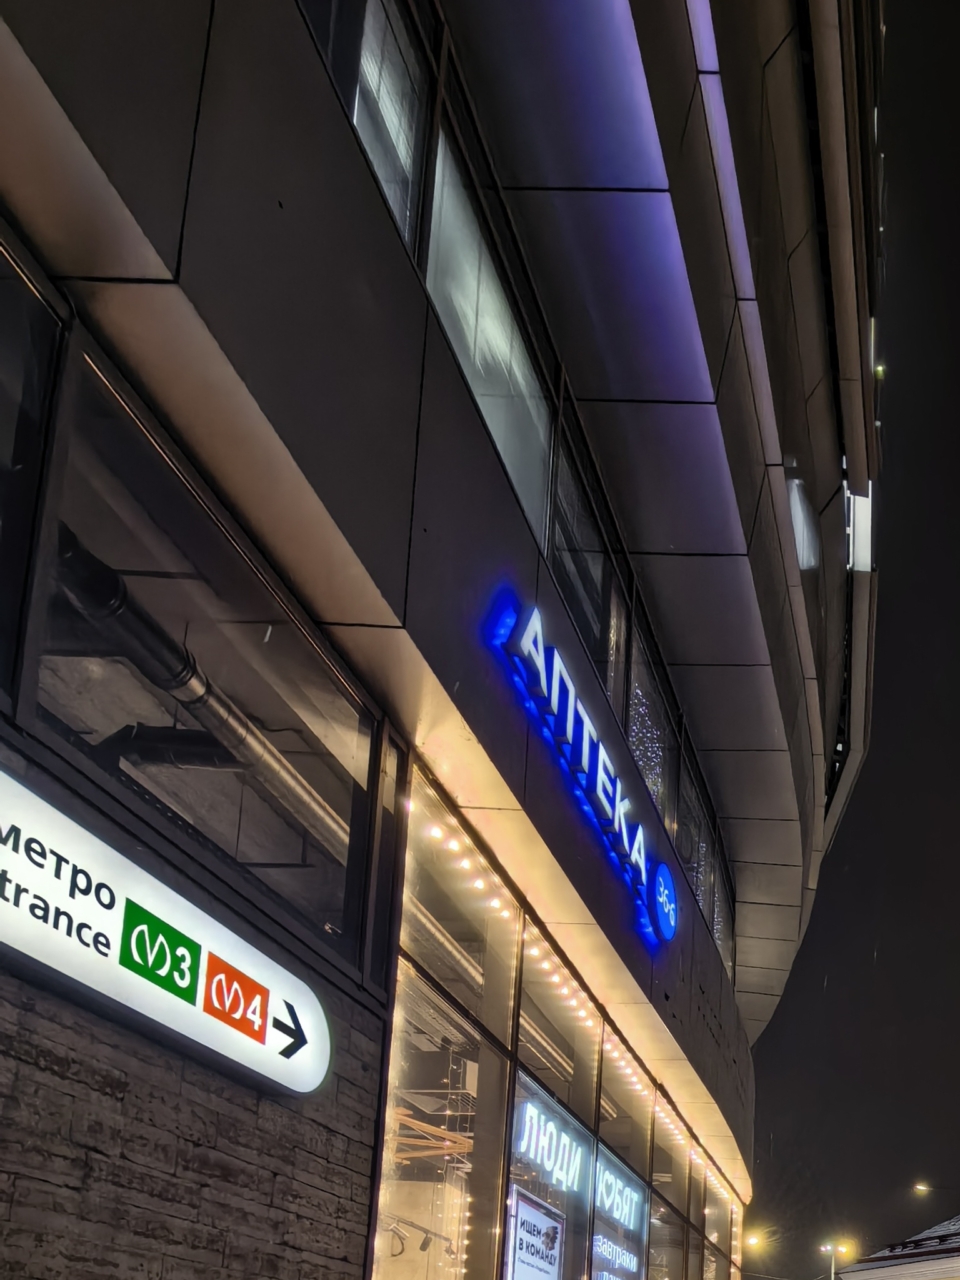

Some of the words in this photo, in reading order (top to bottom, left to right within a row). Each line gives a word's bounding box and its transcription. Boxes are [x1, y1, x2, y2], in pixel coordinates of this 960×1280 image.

[520, 606, 647, 885] АПТЕКА
[0, 823, 116, 911] метро
[0, 868, 111, 957] trance
[520, 1101, 582, 1192] ЛЮДИ
[519, 1237, 524, 1251] В
[525, 1241, 557, 1267] КОМАНДУ
[520, 1217, 542, 1239] ИЩЕМ
[596, 1235, 638, 1273] завтраки
